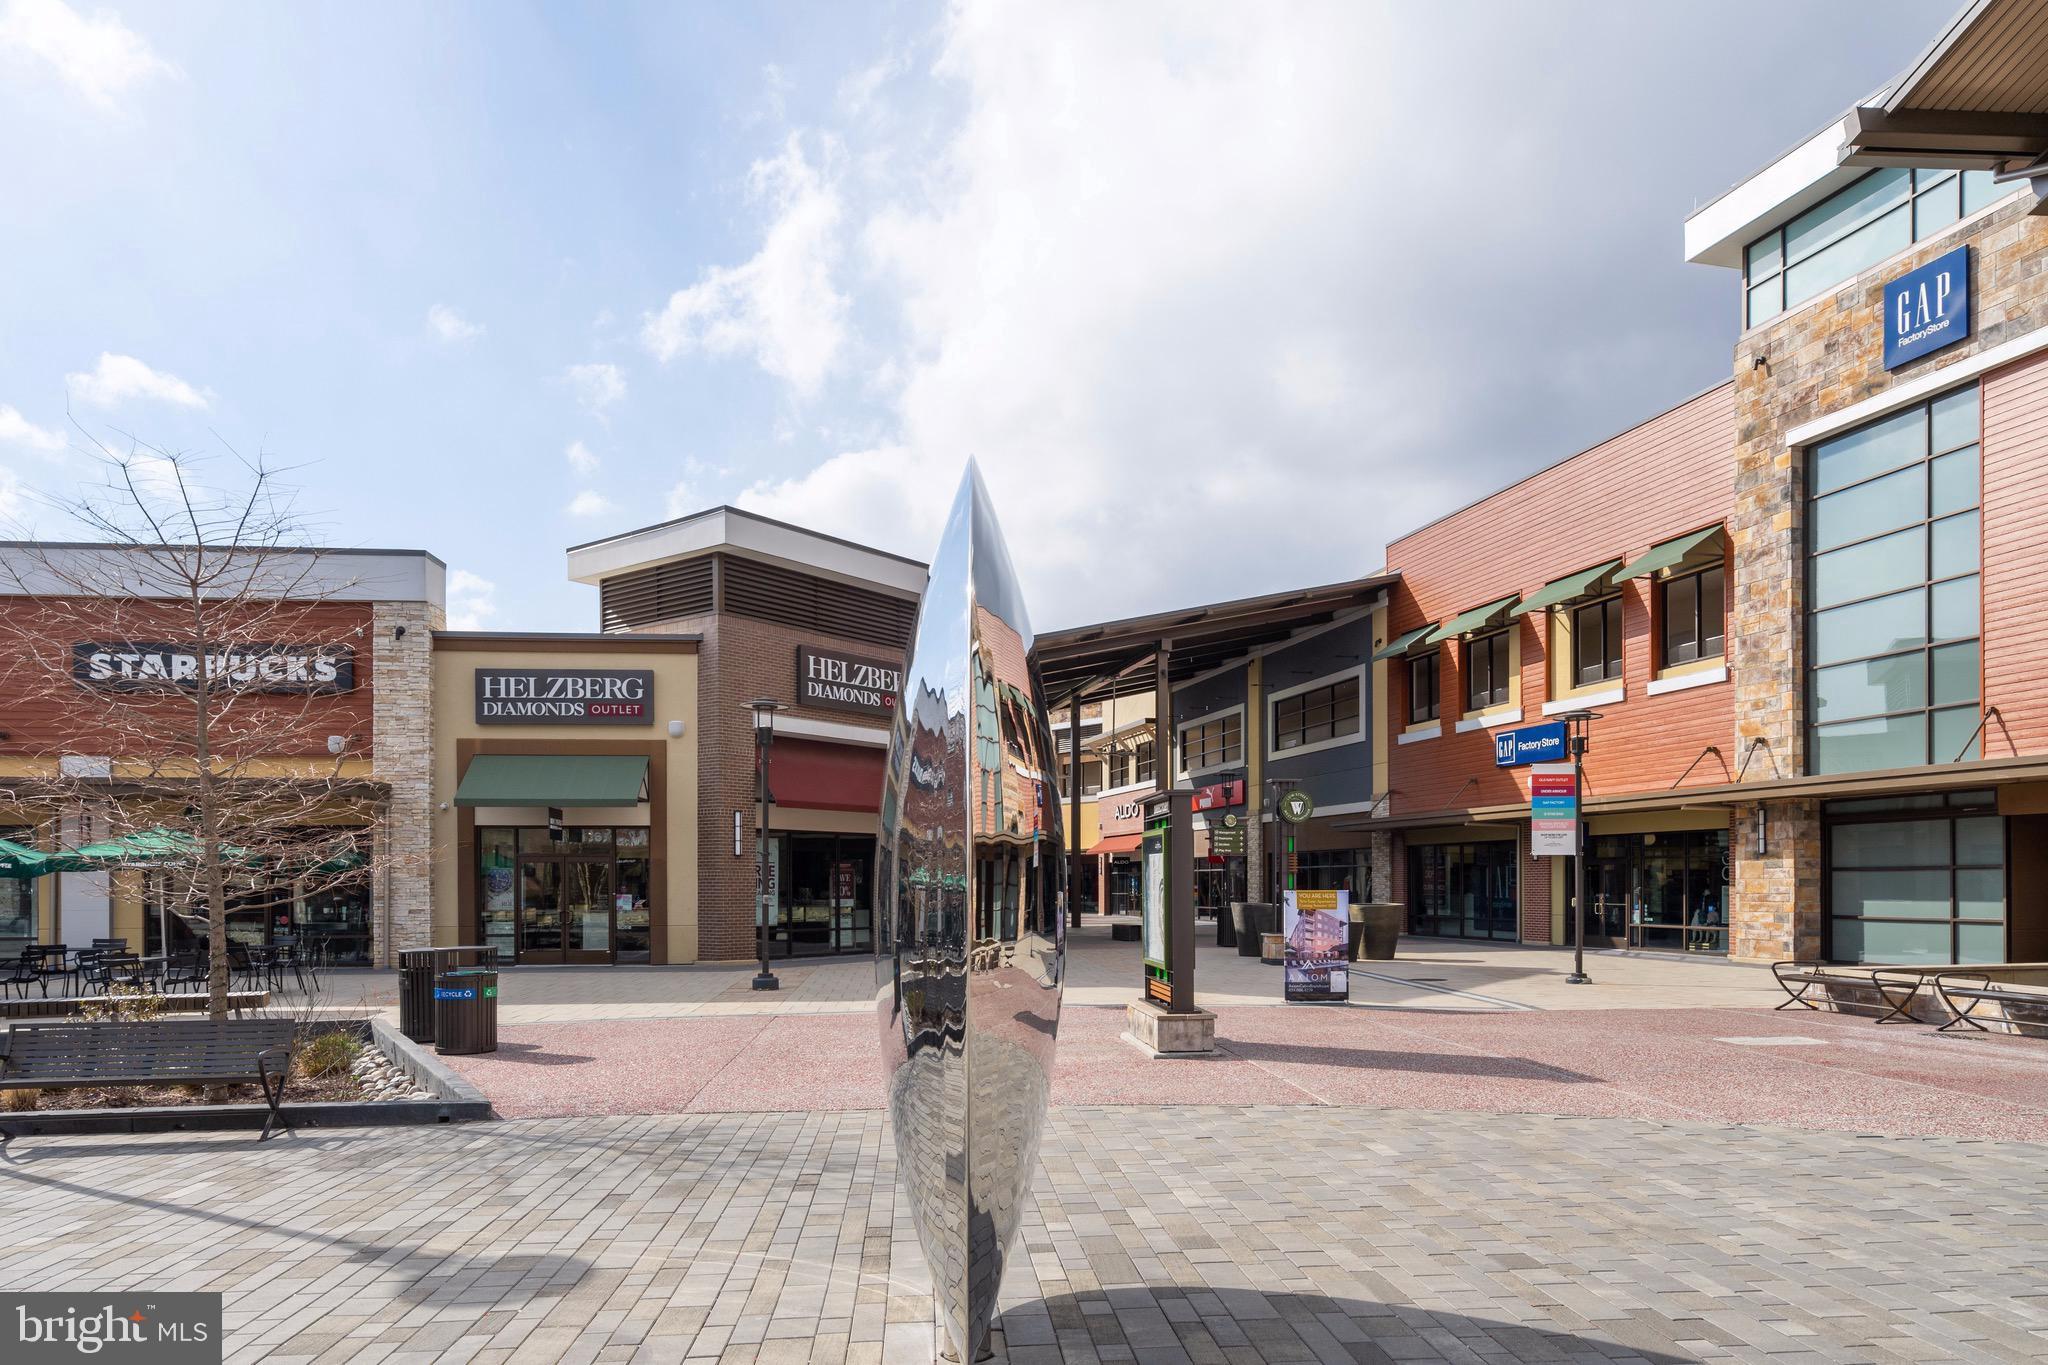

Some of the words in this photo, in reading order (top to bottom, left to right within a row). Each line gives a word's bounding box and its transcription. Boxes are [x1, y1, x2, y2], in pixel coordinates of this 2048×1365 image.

[1897, 272, 1951, 335] GAP
[88, 652, 337, 681] STARBUCKS
[483, 676, 644, 699] HELZBERG
[807, 681, 880, 706] DIAMONDS
[483, 701, 585, 716] DIAMONDS
[591, 705, 640, 714] OUTLET
[1498, 740, 1513, 758] GAP
[1541, 738, 1560, 747] Store
[1115, 803, 1139, 820] ALDO
[1290, 801, 1304, 815] W
[1289, 973, 1328, 981] AXIOM
